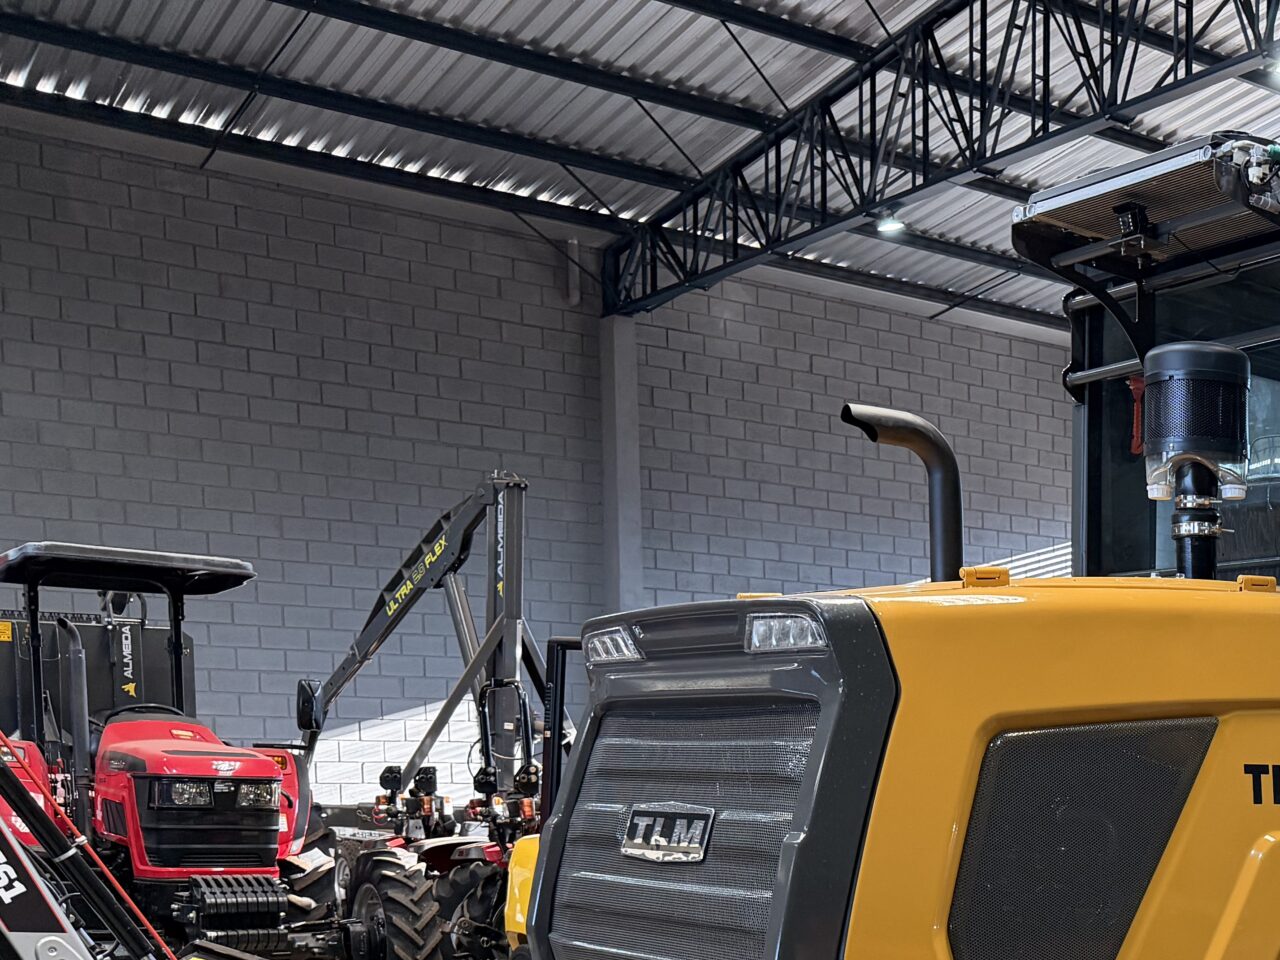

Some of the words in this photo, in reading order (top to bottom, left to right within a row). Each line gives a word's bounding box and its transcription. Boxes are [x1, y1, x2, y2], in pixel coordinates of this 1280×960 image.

[385, 580, 414, 616] ULTRA
[424, 534, 449, 569] FLEX
[122, 625, 134, 679] ALMEIDA
[633, 815, 705, 847] TLM
